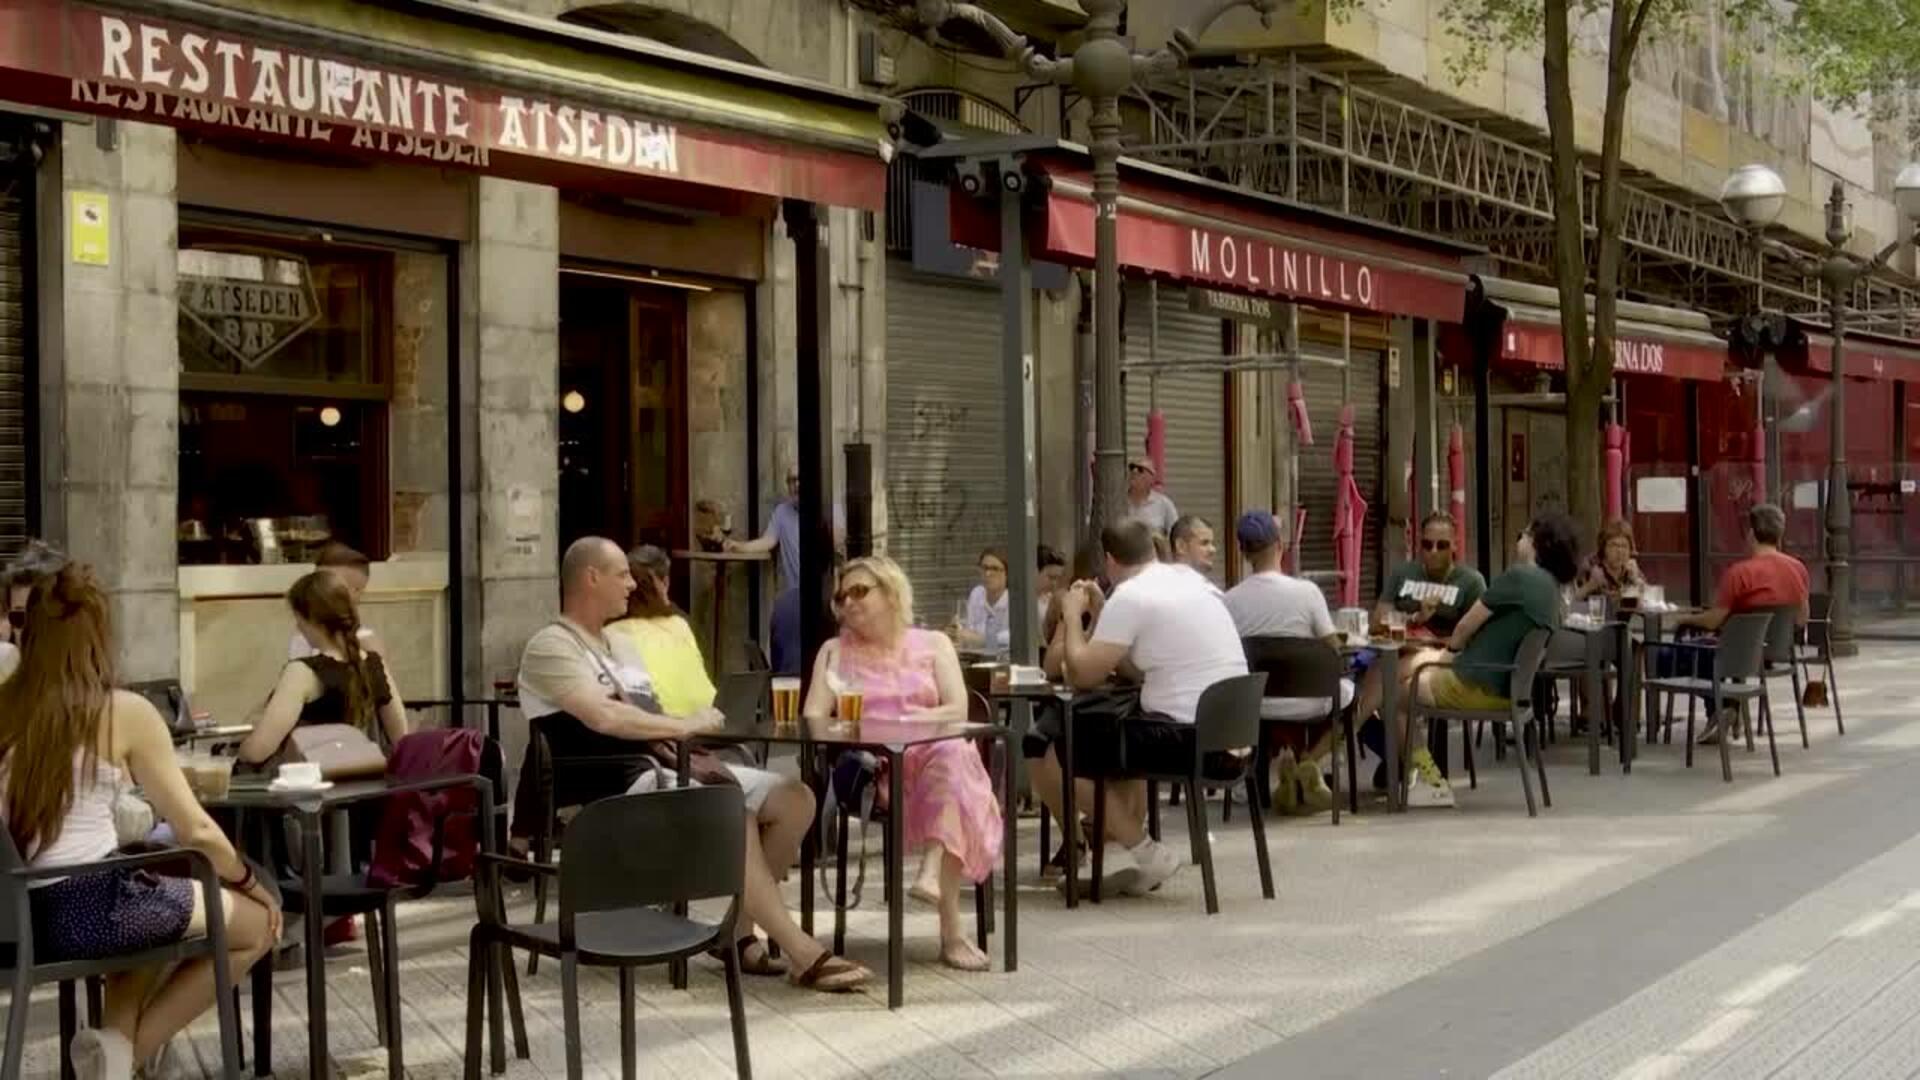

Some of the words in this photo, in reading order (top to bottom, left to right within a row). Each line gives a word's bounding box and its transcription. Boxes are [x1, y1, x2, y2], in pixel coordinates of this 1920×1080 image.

[101, 17, 469, 138] RESTAURANTE
[499, 97, 678, 173] ATSEDEN
[1191, 229, 1372, 304] MOLINILLO
[201, 284, 300, 317] ATSEDEN
[224, 318, 276, 351] BAR
[1612, 339, 1639, 370] RNA
[1641, 344, 1663, 373] DOS
